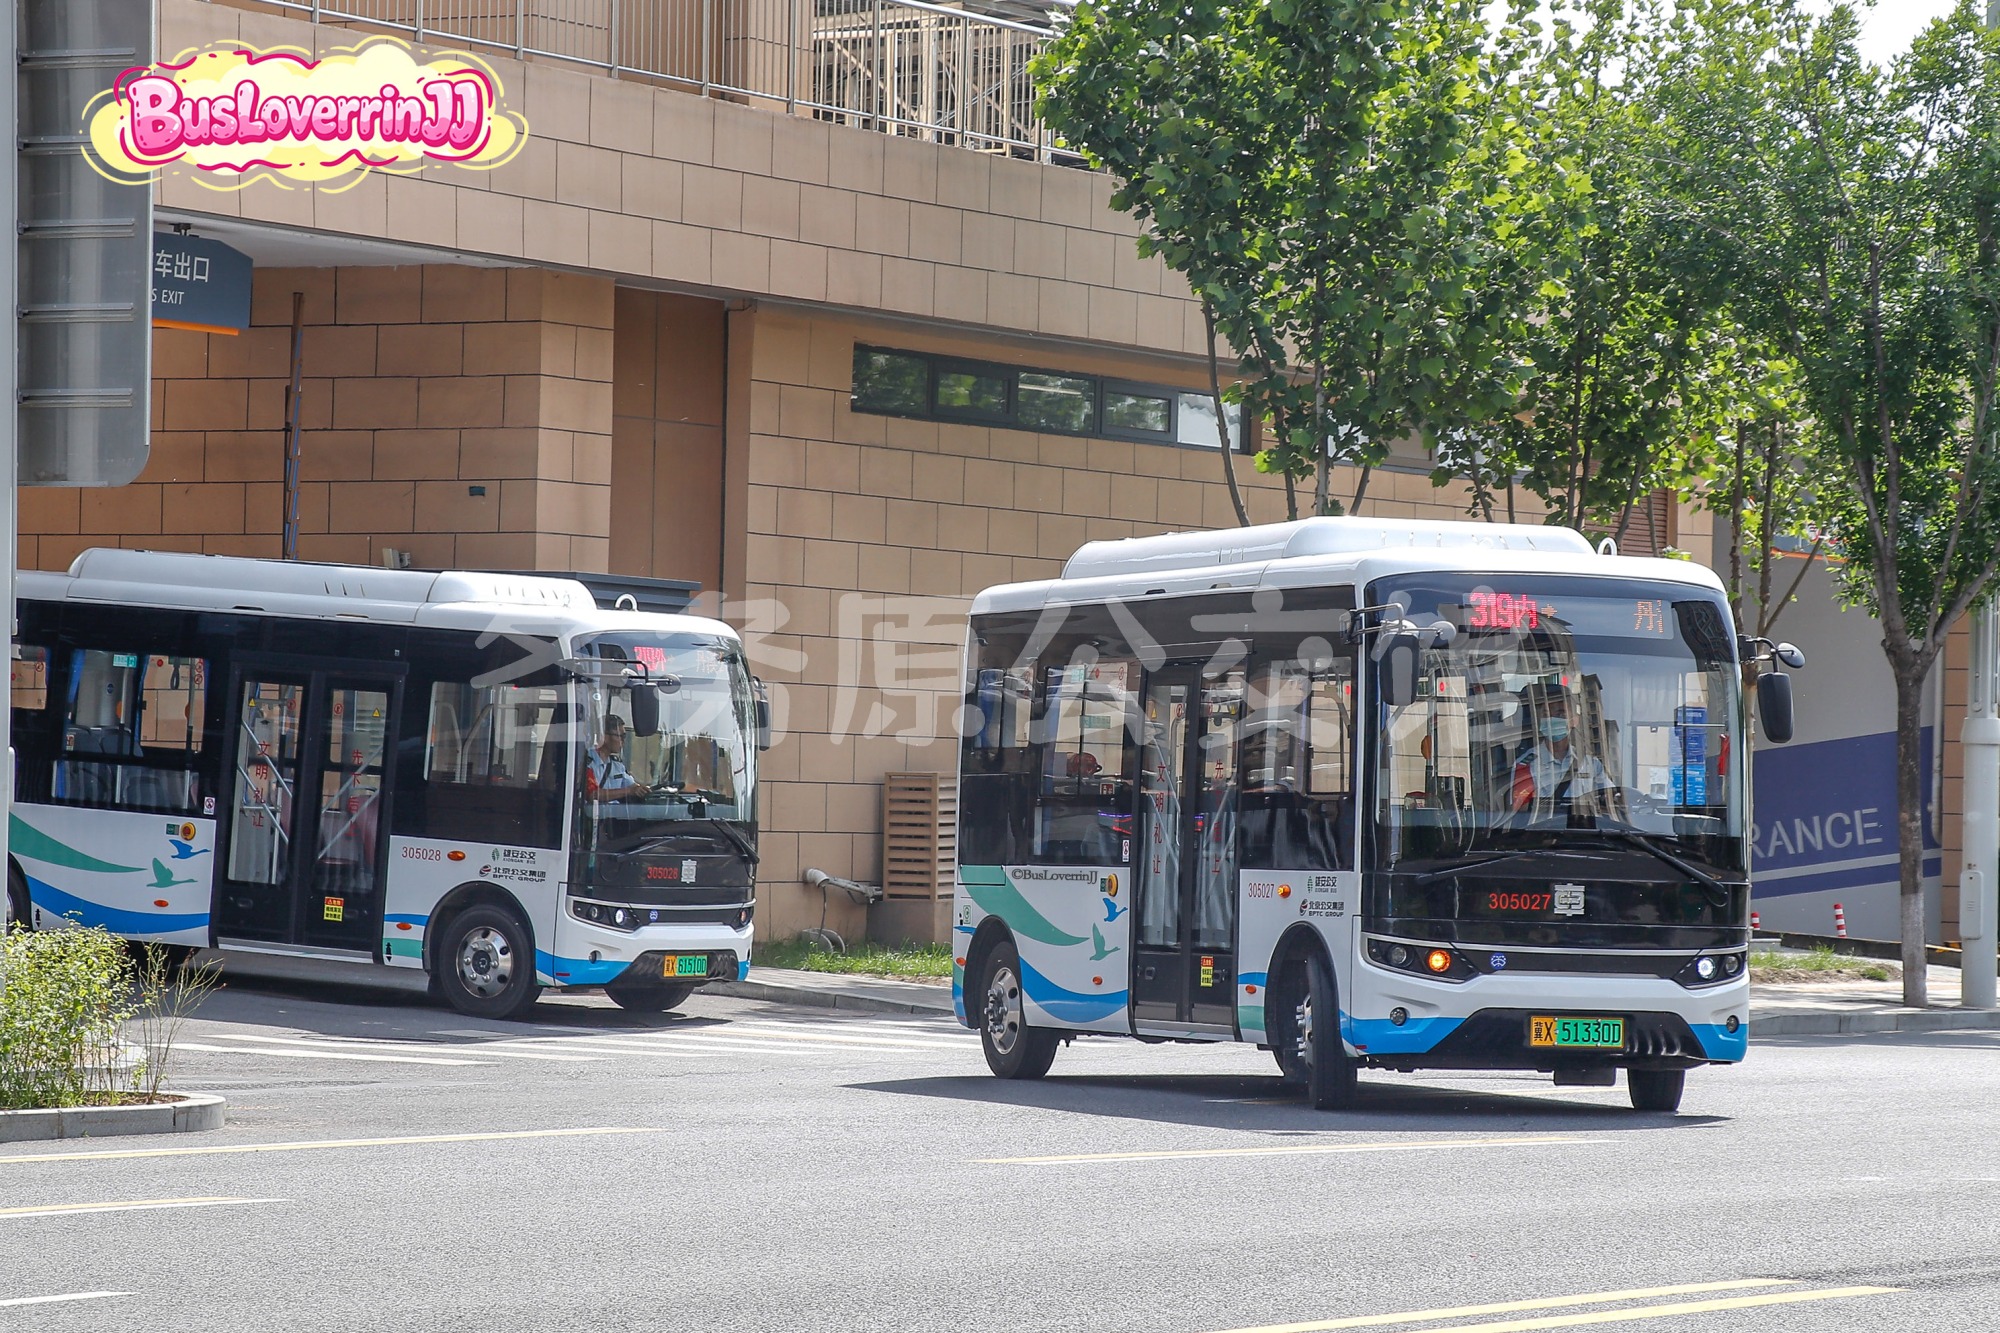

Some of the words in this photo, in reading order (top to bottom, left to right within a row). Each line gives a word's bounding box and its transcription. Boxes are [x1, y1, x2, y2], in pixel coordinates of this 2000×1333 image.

[154, 249, 210, 283] 车出口
[161, 289, 185, 305] EXIT
[1469, 592, 1539, 628] 319内
[252, 740, 271, 828] 文明礼让
[1152, 762, 1167, 875] 文明礼让
[402, 846, 441, 861] 305028
[492, 873, 514, 881] BPTC
[493, 866, 546, 878] 北京公交集团
[647, 866, 679, 879] 305028
[1248, 882, 1275, 898] 305027
[1308, 901, 1344, 911] 北京公交集团
[1488, 893, 1552, 910] 305027
